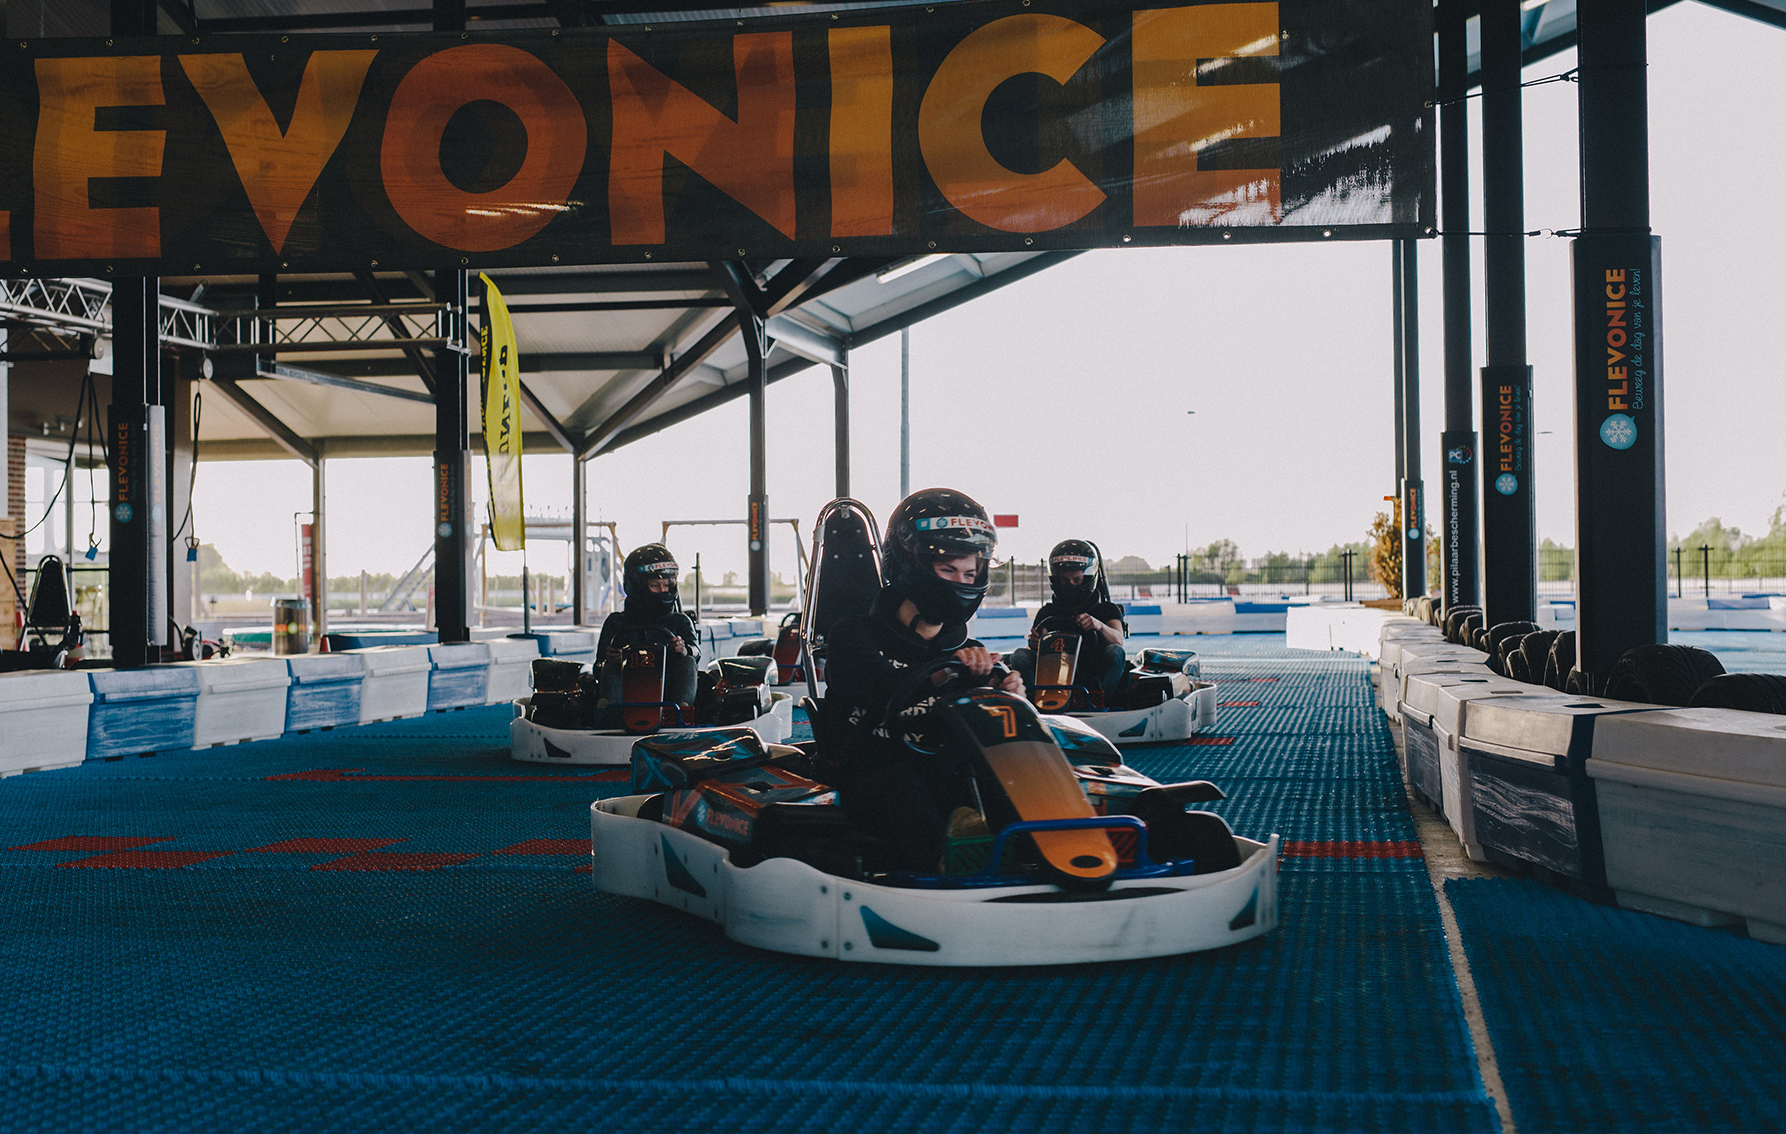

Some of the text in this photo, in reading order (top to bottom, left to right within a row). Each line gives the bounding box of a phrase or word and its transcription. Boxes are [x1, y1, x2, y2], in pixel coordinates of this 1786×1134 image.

[0, 2, 1281, 262] EVONICE
[1605, 268, 1628, 410] FLEVONICE
[1629, 268, 1647, 410] Beweeg de dag van je leven!
[117, 422, 129, 502] FLEVONICE
[1449, 450, 1461, 460] PC
[1499, 385, 1513, 472] FLEVONICE
[440, 463, 450, 522] FLEVONICE
[1449, 470, 1461, 604] www.pilaarbescherming.nl
[629, 651, 655, 668] 12
[1050, 637, 1065, 652] 4
[979, 703, 1017, 738] 7
[704, 808, 749, 836] FLEVONICE
